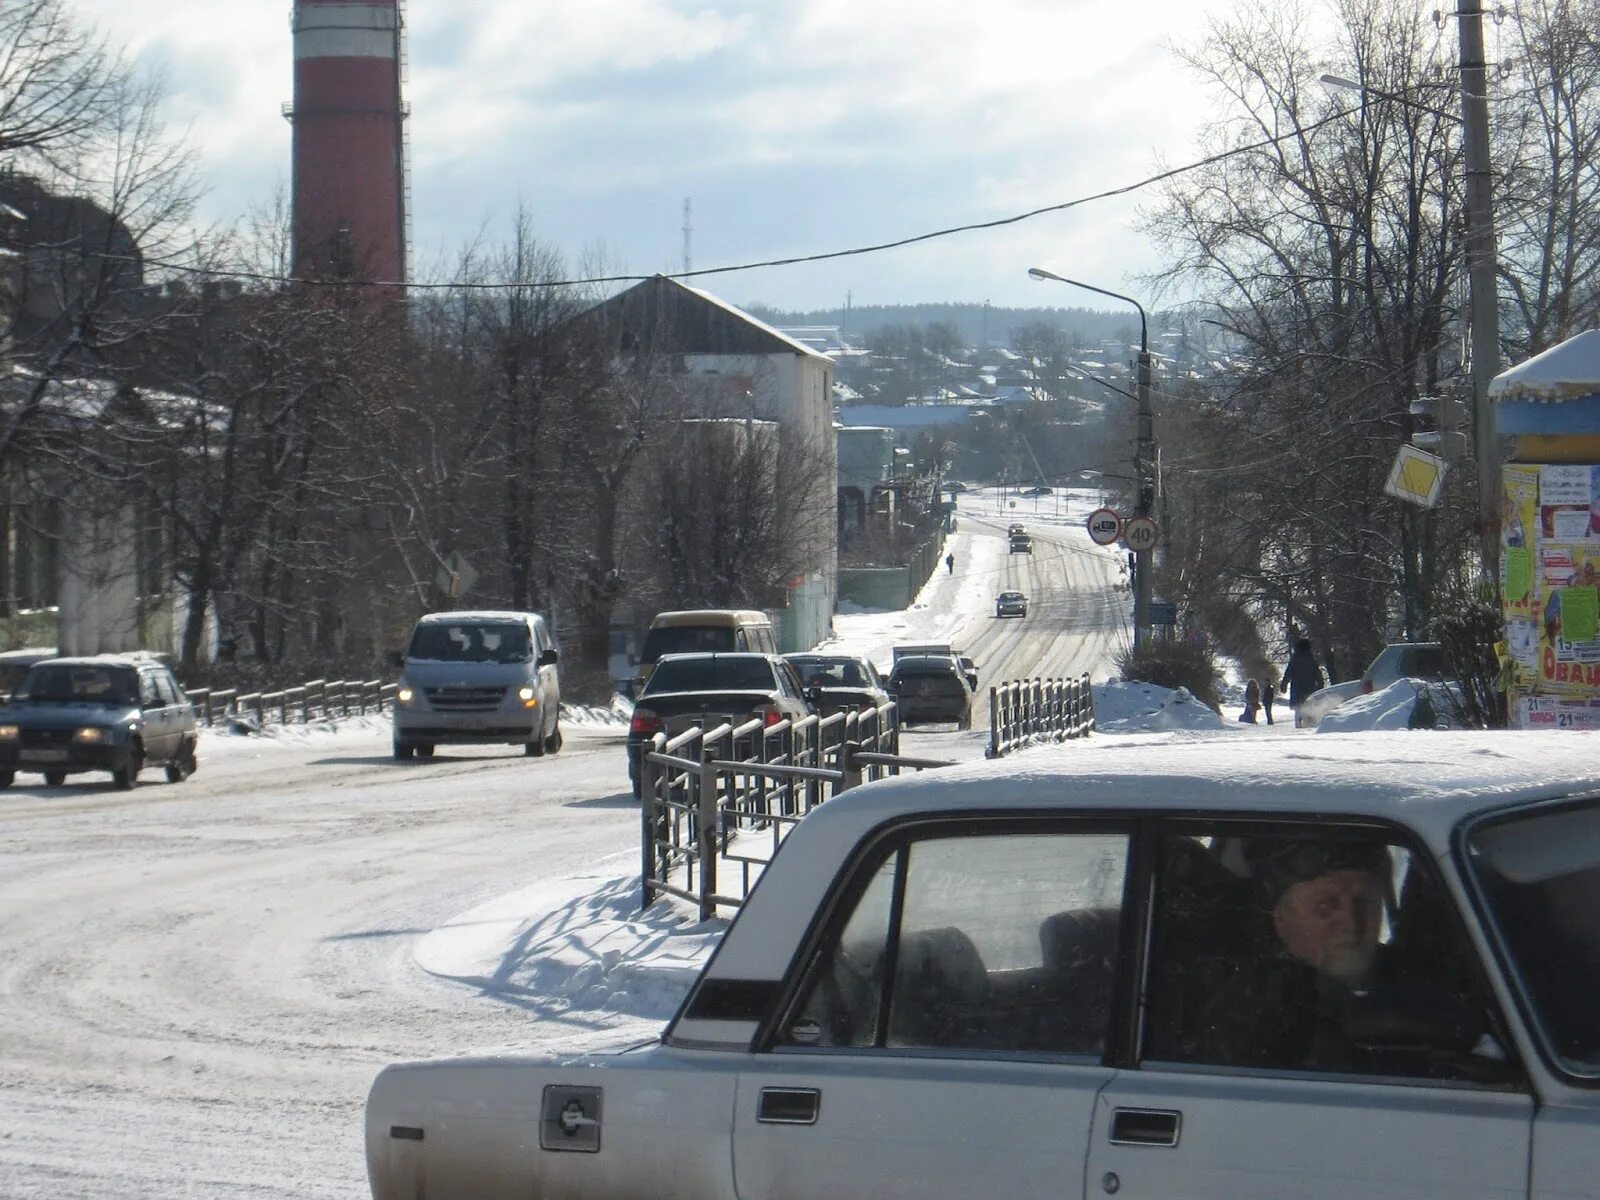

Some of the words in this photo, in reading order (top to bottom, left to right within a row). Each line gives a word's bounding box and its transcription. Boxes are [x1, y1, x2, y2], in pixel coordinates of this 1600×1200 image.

[1131, 527, 1151, 543] 40
[1528, 698, 1538, 711] 21
[1559, 714, 1573, 726] 21
